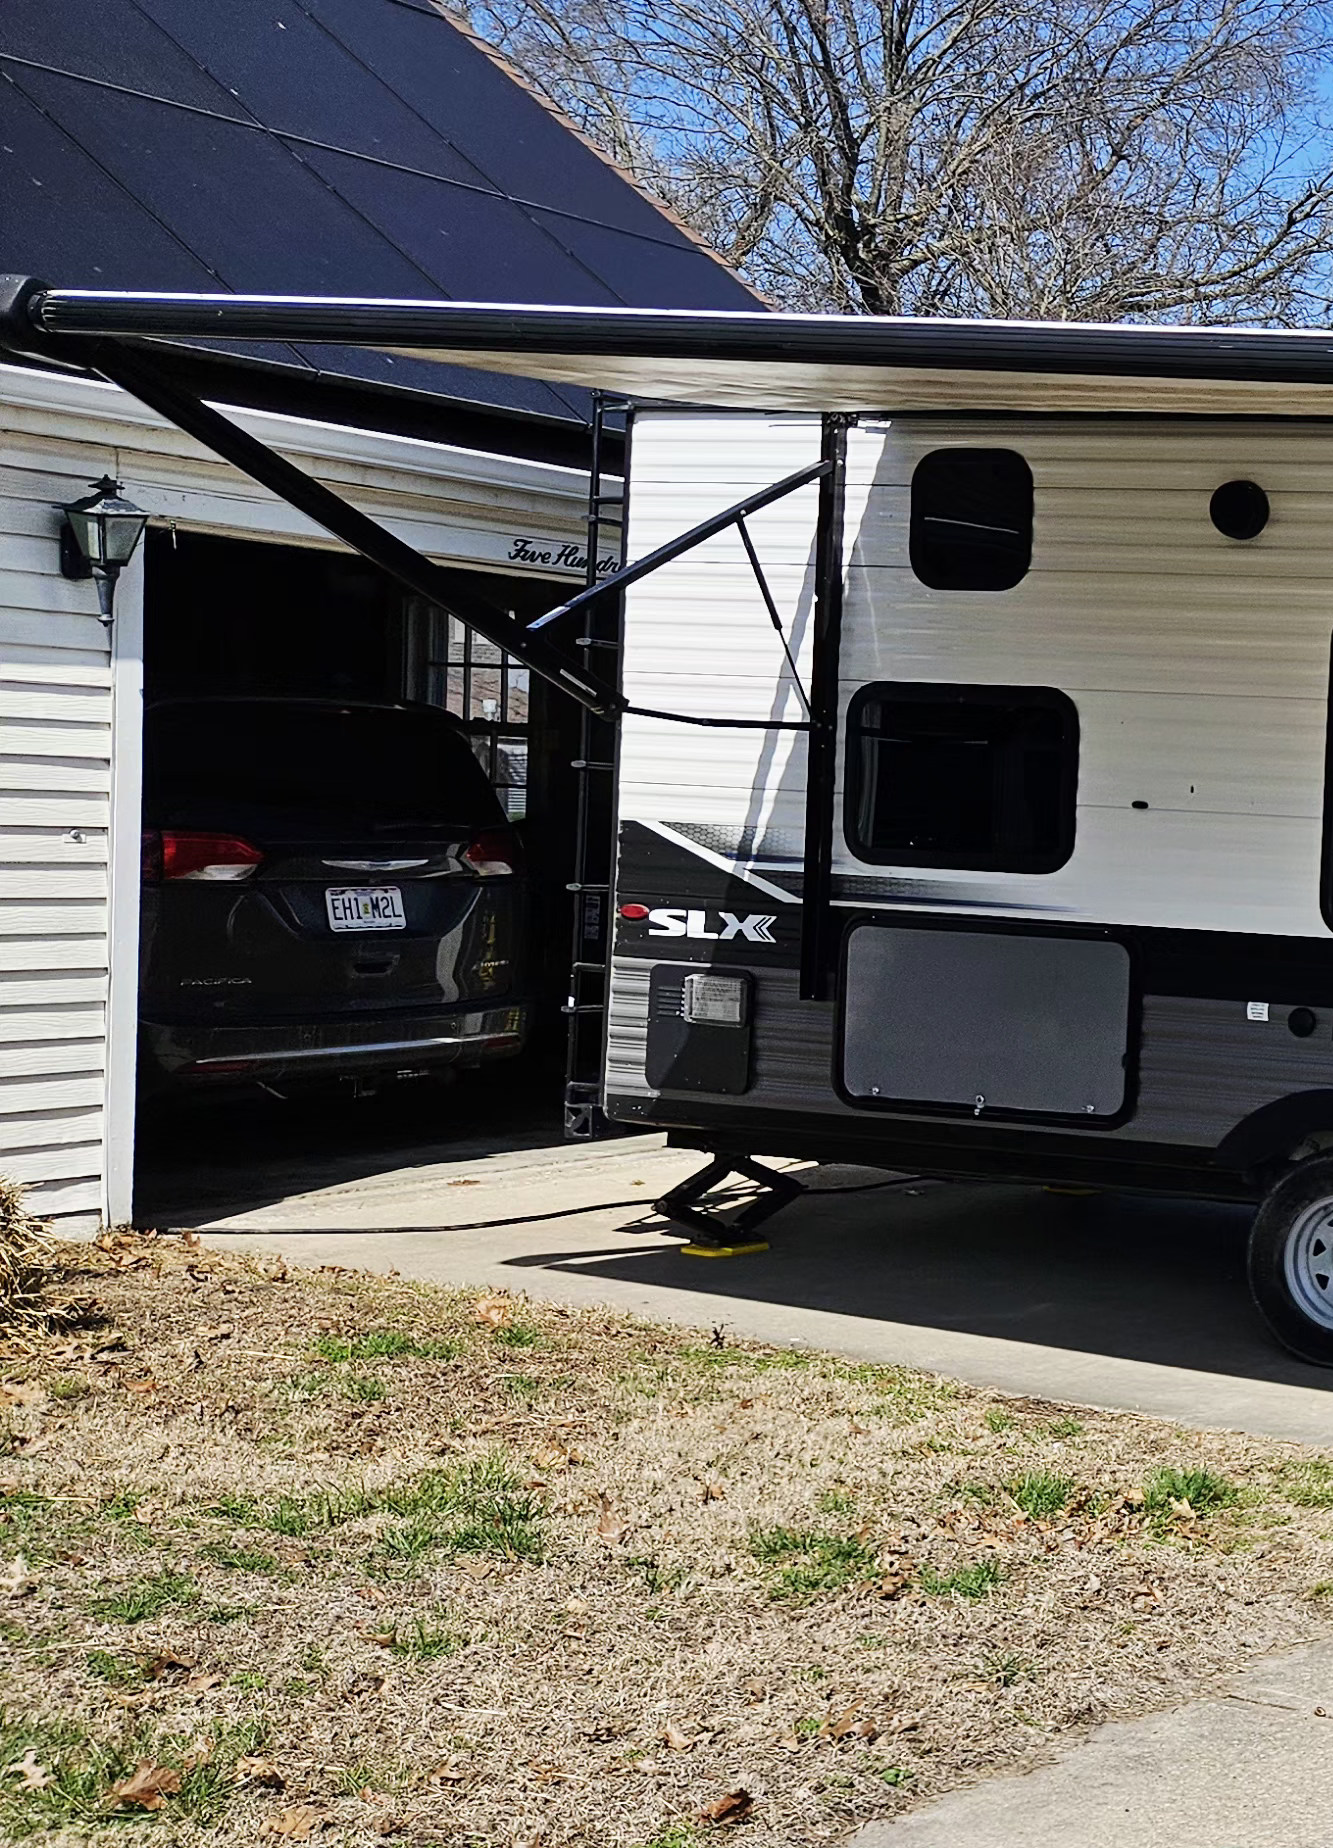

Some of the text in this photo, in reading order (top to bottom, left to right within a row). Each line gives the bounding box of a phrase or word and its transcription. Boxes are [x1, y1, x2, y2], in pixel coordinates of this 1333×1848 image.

[508, 539, 551, 563] Five
[331, 898, 363, 920] EH1
[370, 896, 402, 919] M2L
[649, 908, 777, 943] SLX
